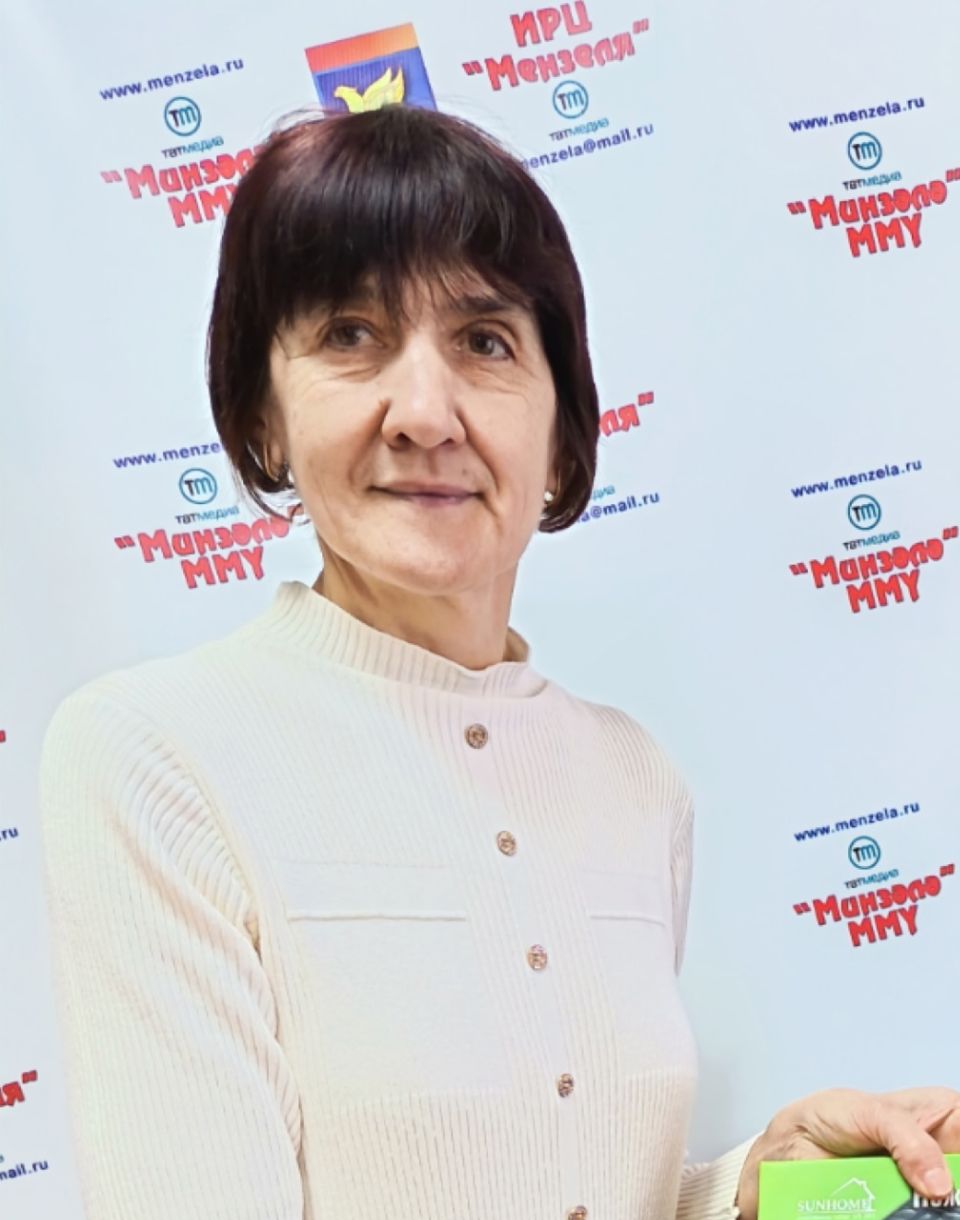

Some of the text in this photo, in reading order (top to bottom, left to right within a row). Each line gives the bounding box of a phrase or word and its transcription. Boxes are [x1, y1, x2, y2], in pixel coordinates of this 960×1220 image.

[510, 0, 592, 47] ИРЦ
[99, 58, 244, 100] www.menzela.ru
[789, 97, 925, 132] www.menzela.ru
[168, 184, 239, 228] ММ
[113, 442, 220, 468] www.menze
[791, 460, 922, 498] www.menzela.ru
[794, 802, 920, 841] www.menzela.ru
[797, 1198, 873, 1211] SUNHOME
